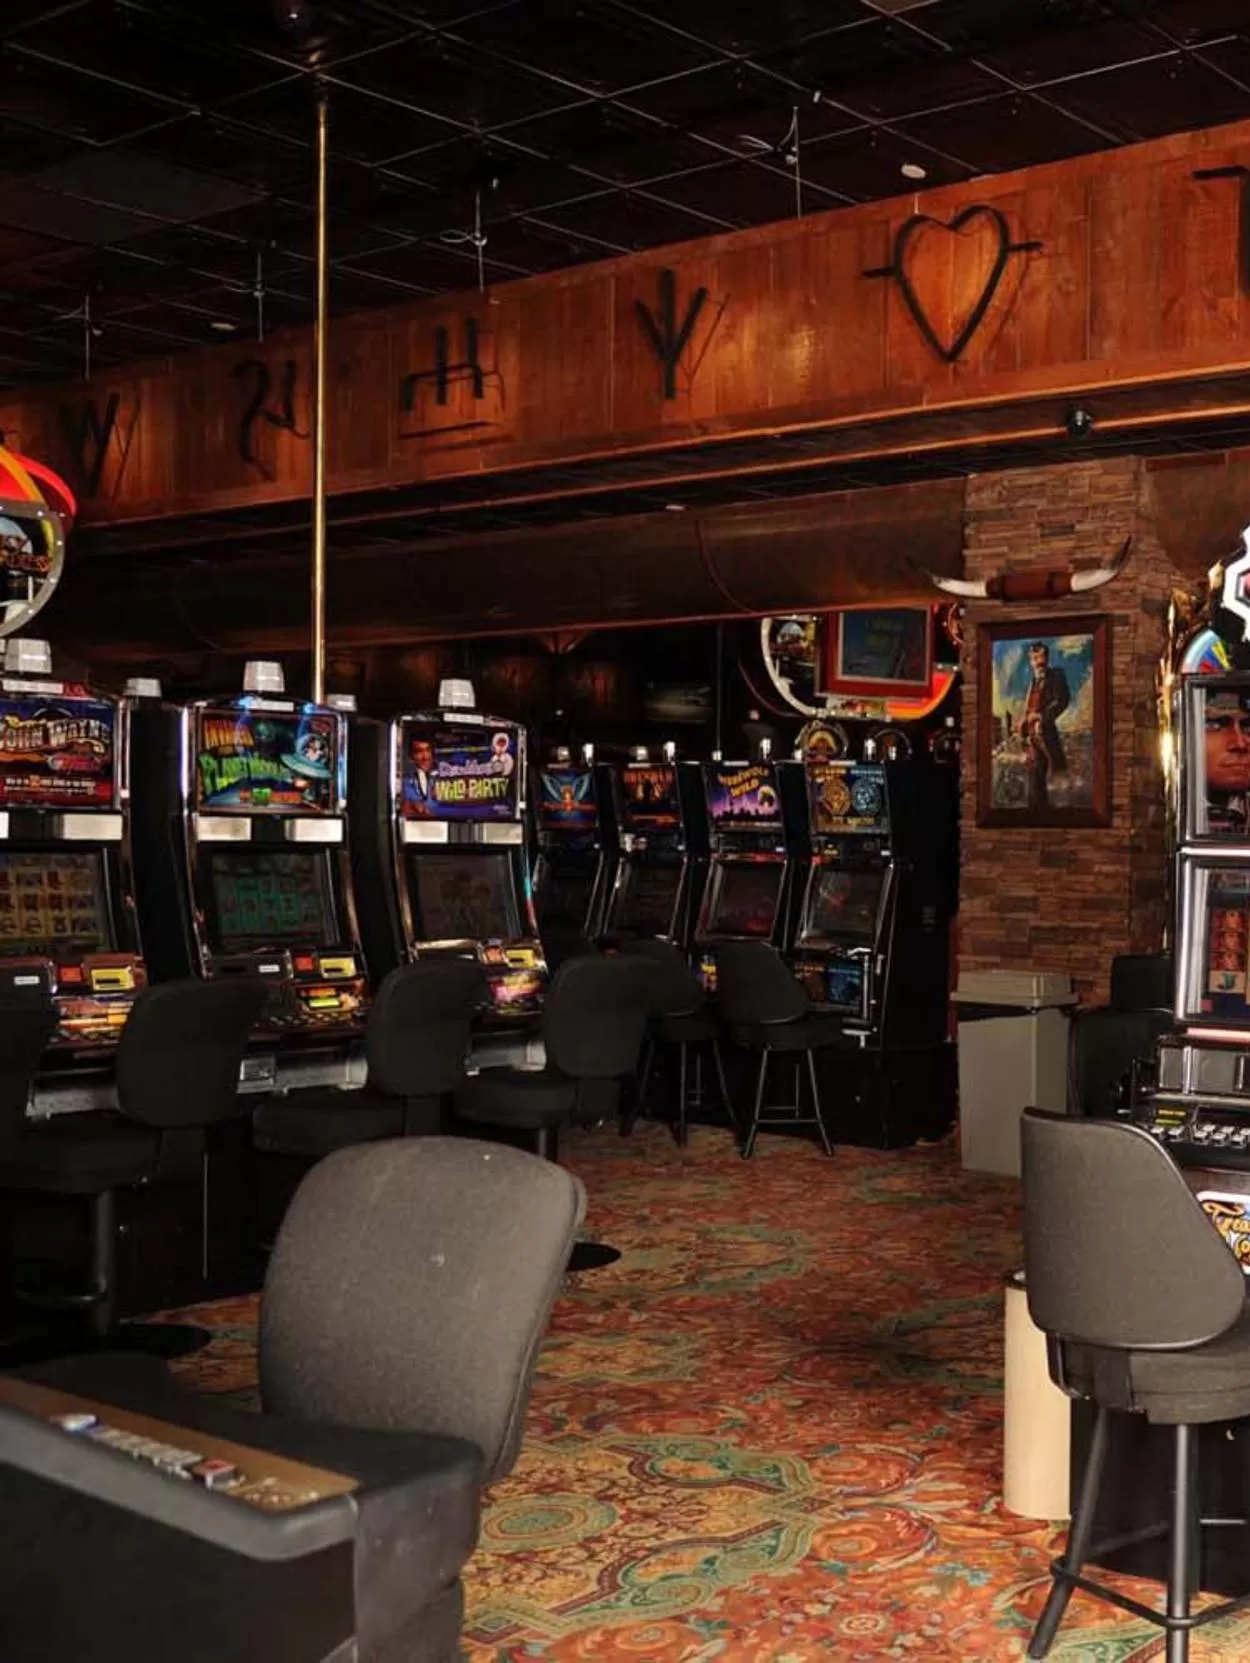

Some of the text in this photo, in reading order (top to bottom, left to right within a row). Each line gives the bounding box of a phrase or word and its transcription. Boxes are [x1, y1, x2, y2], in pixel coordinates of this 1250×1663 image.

[435, 777, 509, 800] WILD PARTY
[730, 778, 760, 798] WILD
